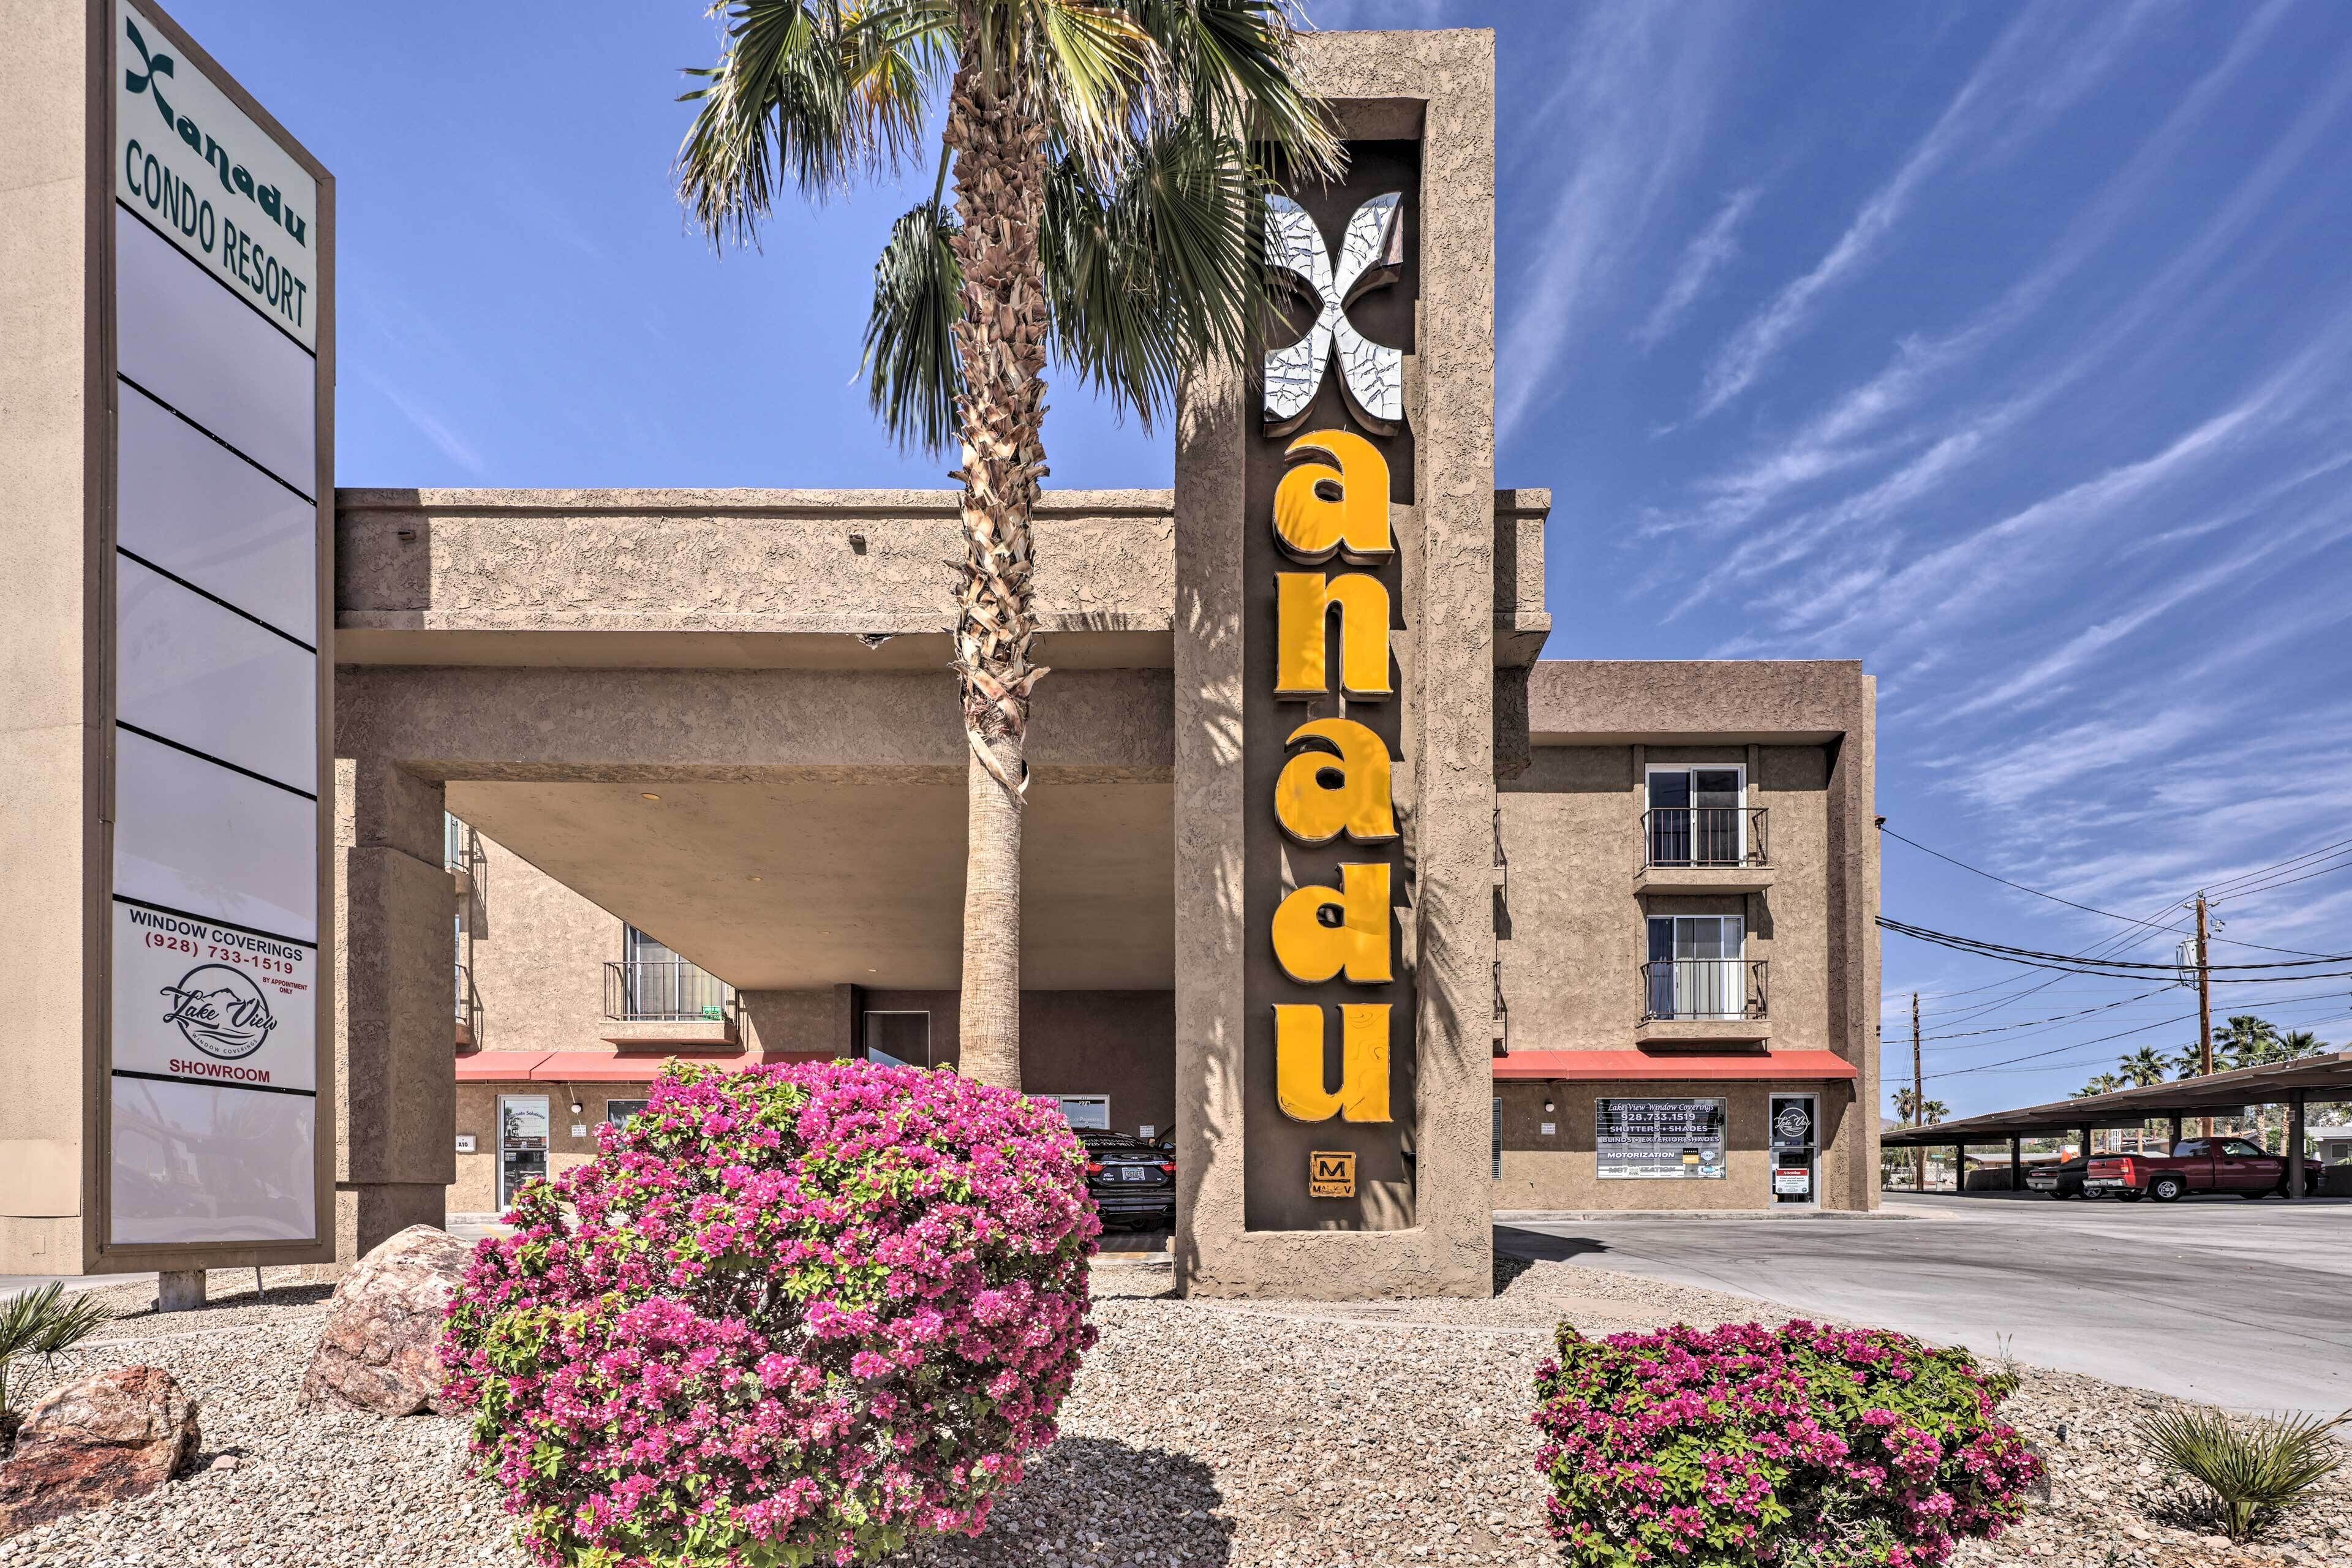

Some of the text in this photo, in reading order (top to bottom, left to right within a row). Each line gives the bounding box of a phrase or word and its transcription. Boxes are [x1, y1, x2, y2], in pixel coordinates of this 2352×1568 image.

[126, 15, 306, 248] Xanadu
[126, 139, 306, 328] CONDO RESORT
[130, 909, 303, 961] WINDOW COVERINGS
[145, 932, 293, 974] (928) 733-1519
[271, 978, 307, 990] APPOINTMENT
[160, 986, 277, 1031] Lake View
[192, 1033, 258, 1054] WINDOW COVERINGS
[169, 1059, 270, 1083] SHOWROOM
[526, 1110, 545, 1120] Solutions
[1627, 1102, 1646, 1111] View
[1648, 1102, 1676, 1111] Window
[1678, 1103, 1714, 1112] Coverings
[1774, 1117, 1792, 1128] Lake
[1320, 1161, 1345, 1177] M
